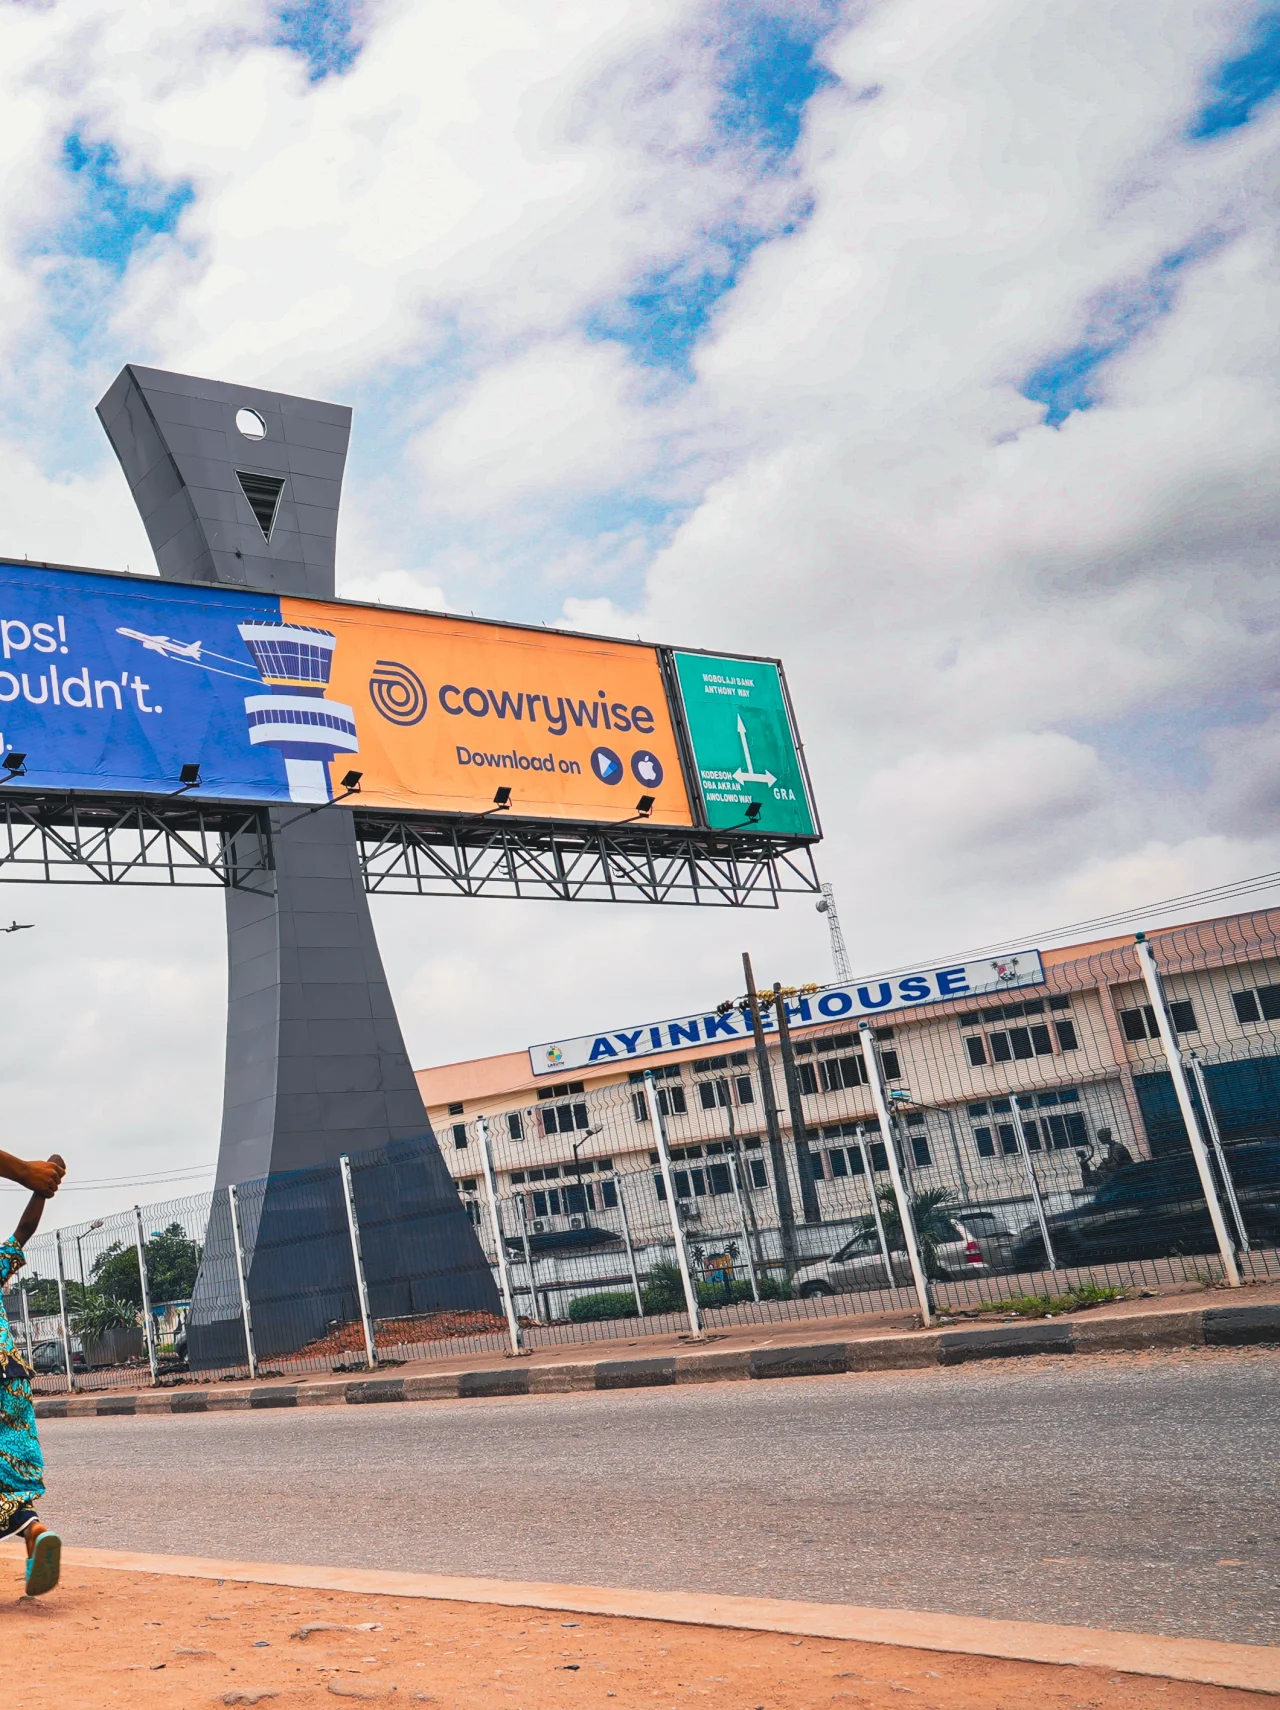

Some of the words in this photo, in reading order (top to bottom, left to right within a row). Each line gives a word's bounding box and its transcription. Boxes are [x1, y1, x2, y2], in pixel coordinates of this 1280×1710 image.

[703, 673, 736, 685] MOBOLAJI
[736, 678, 755, 687] BANK
[704, 685, 736, 697] ANTHONY
[737, 688, 750, 697] WAY
[439, 682, 655, 736] cowrywise
[456, 745, 554, 773] Download
[557, 757, 581, 775] on
[701, 770, 733, 781] KODESOH
[703, 780, 717, 790] OBA
[717, 781, 741, 791] AKRAN
[706, 792, 739, 803] AWOLOWO
[739, 794, 752, 803] WAY
[773, 787, 796, 801] GRA
[588, 1009, 773, 1061] AYINKE
[785, 967, 970, 1024] HOUSE
